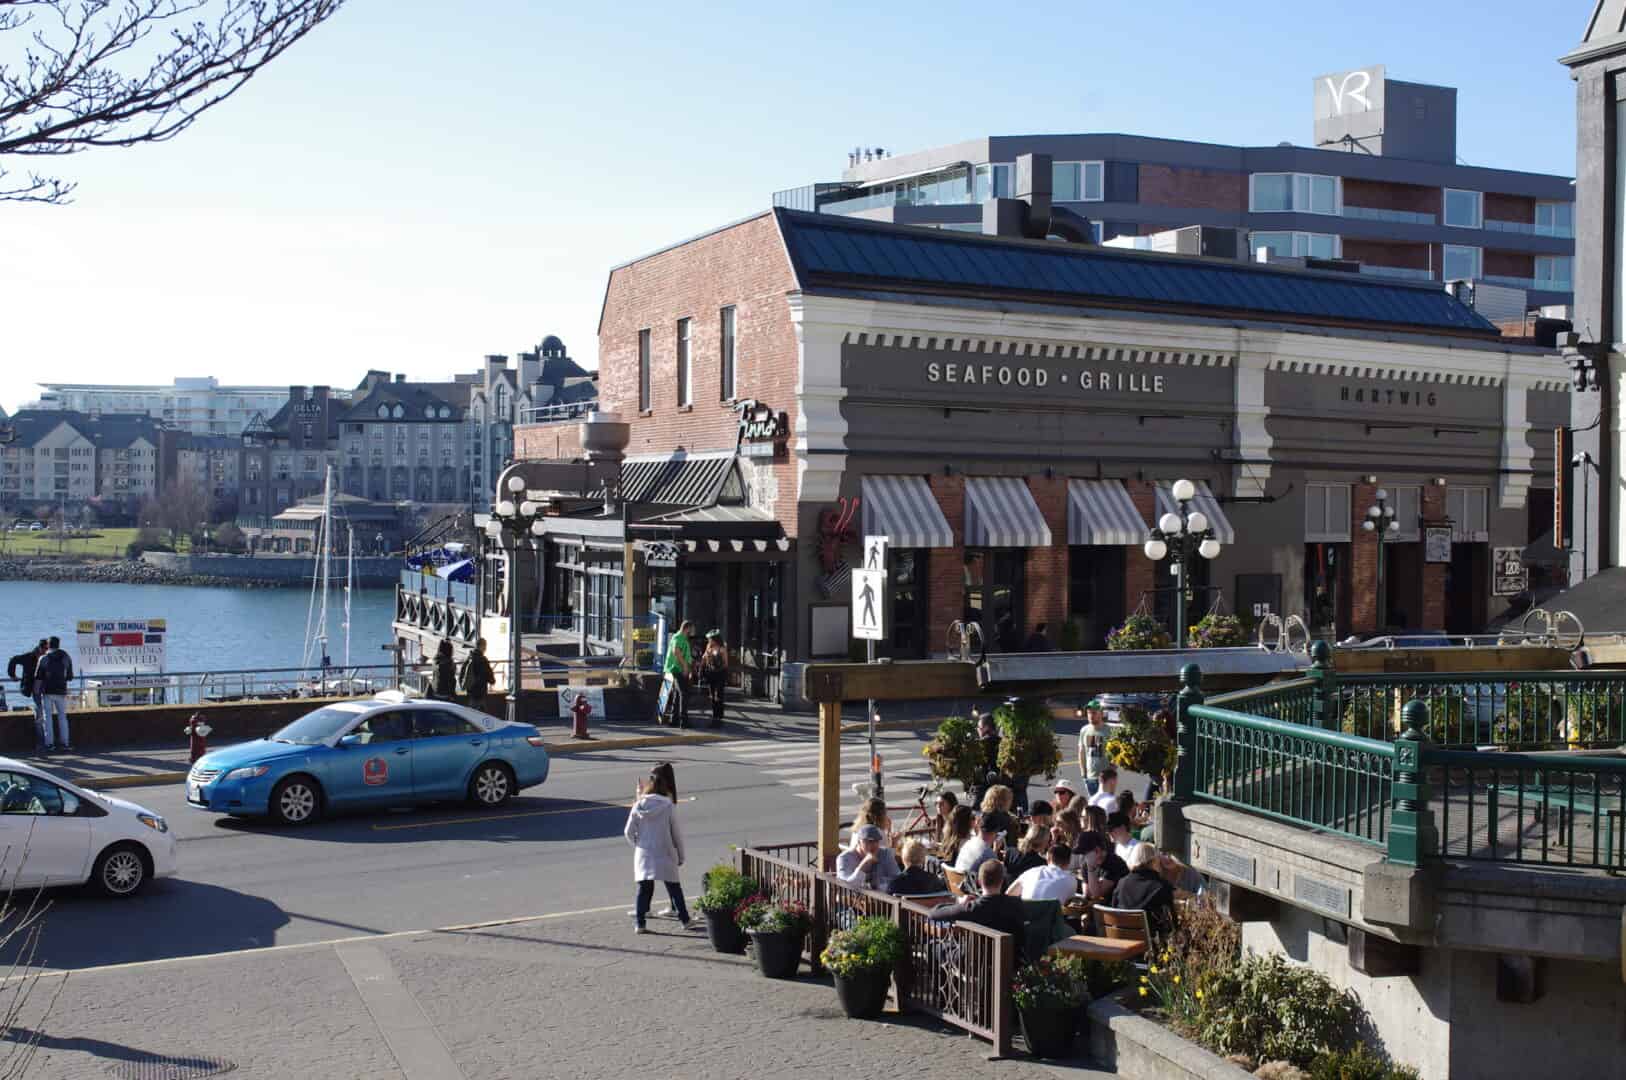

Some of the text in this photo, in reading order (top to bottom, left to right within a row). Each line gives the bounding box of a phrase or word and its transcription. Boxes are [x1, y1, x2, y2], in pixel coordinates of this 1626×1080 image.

[1325, 71, 1371, 115] VR
[927, 362, 1164, 393] SEAFOOD GRILLE
[1340, 385, 1437, 407] HARTWIG
[293, 404, 321, 412] DELTA
[118, 622, 146, 631] TERMINAL
[80, 646, 163, 656] WHALE SIGHTINGS
[88, 655, 158, 665] GUARANTEED
